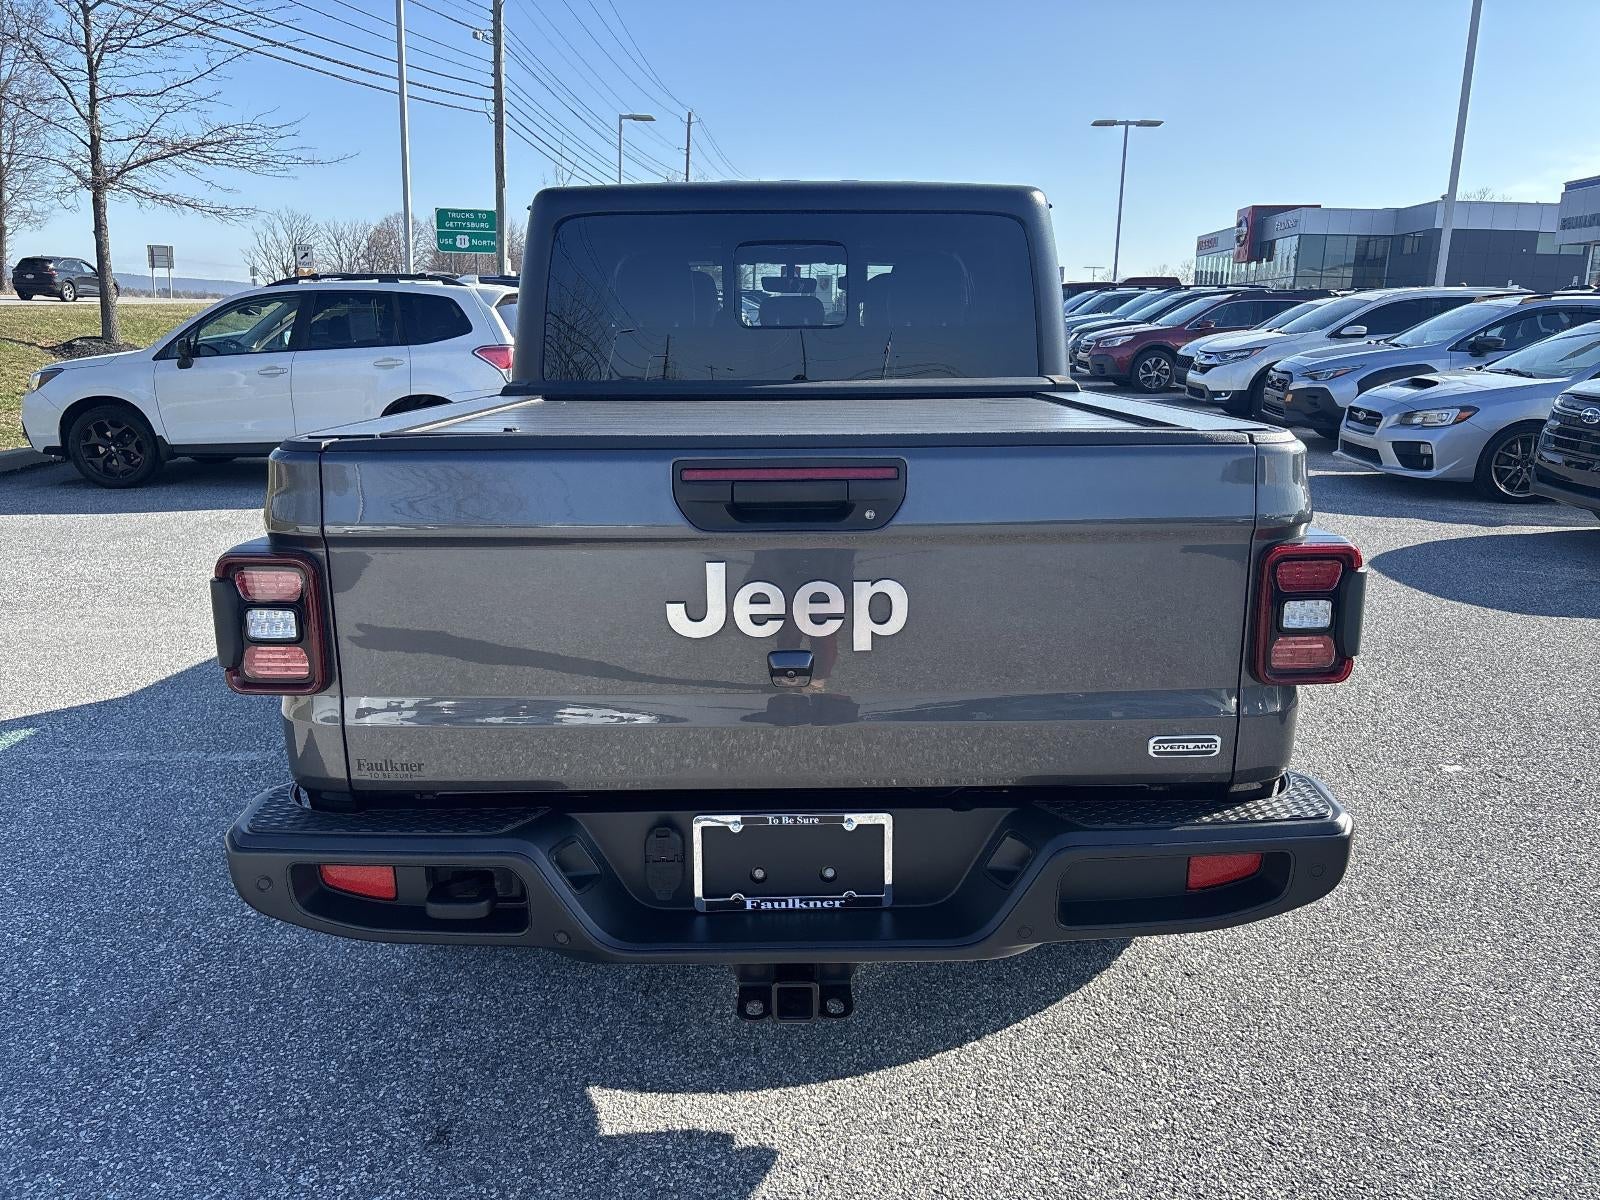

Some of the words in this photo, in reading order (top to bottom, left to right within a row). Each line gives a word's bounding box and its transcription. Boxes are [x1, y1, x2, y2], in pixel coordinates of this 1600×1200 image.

[447, 211, 475, 219] TRUCKS
[445, 221, 489, 229] GETTYSBURG
[471, 238, 496, 246] NORTH
[665, 561, 909, 651] Jeep
[1152, 743, 1218, 751] OVERLAND
[356, 758, 425, 772] Faulkner
[766, 816, 779, 825] To
[782, 816, 795, 824] Be
[797, 815, 820, 824] Sure
[744, 898, 846, 910] Faulkner
